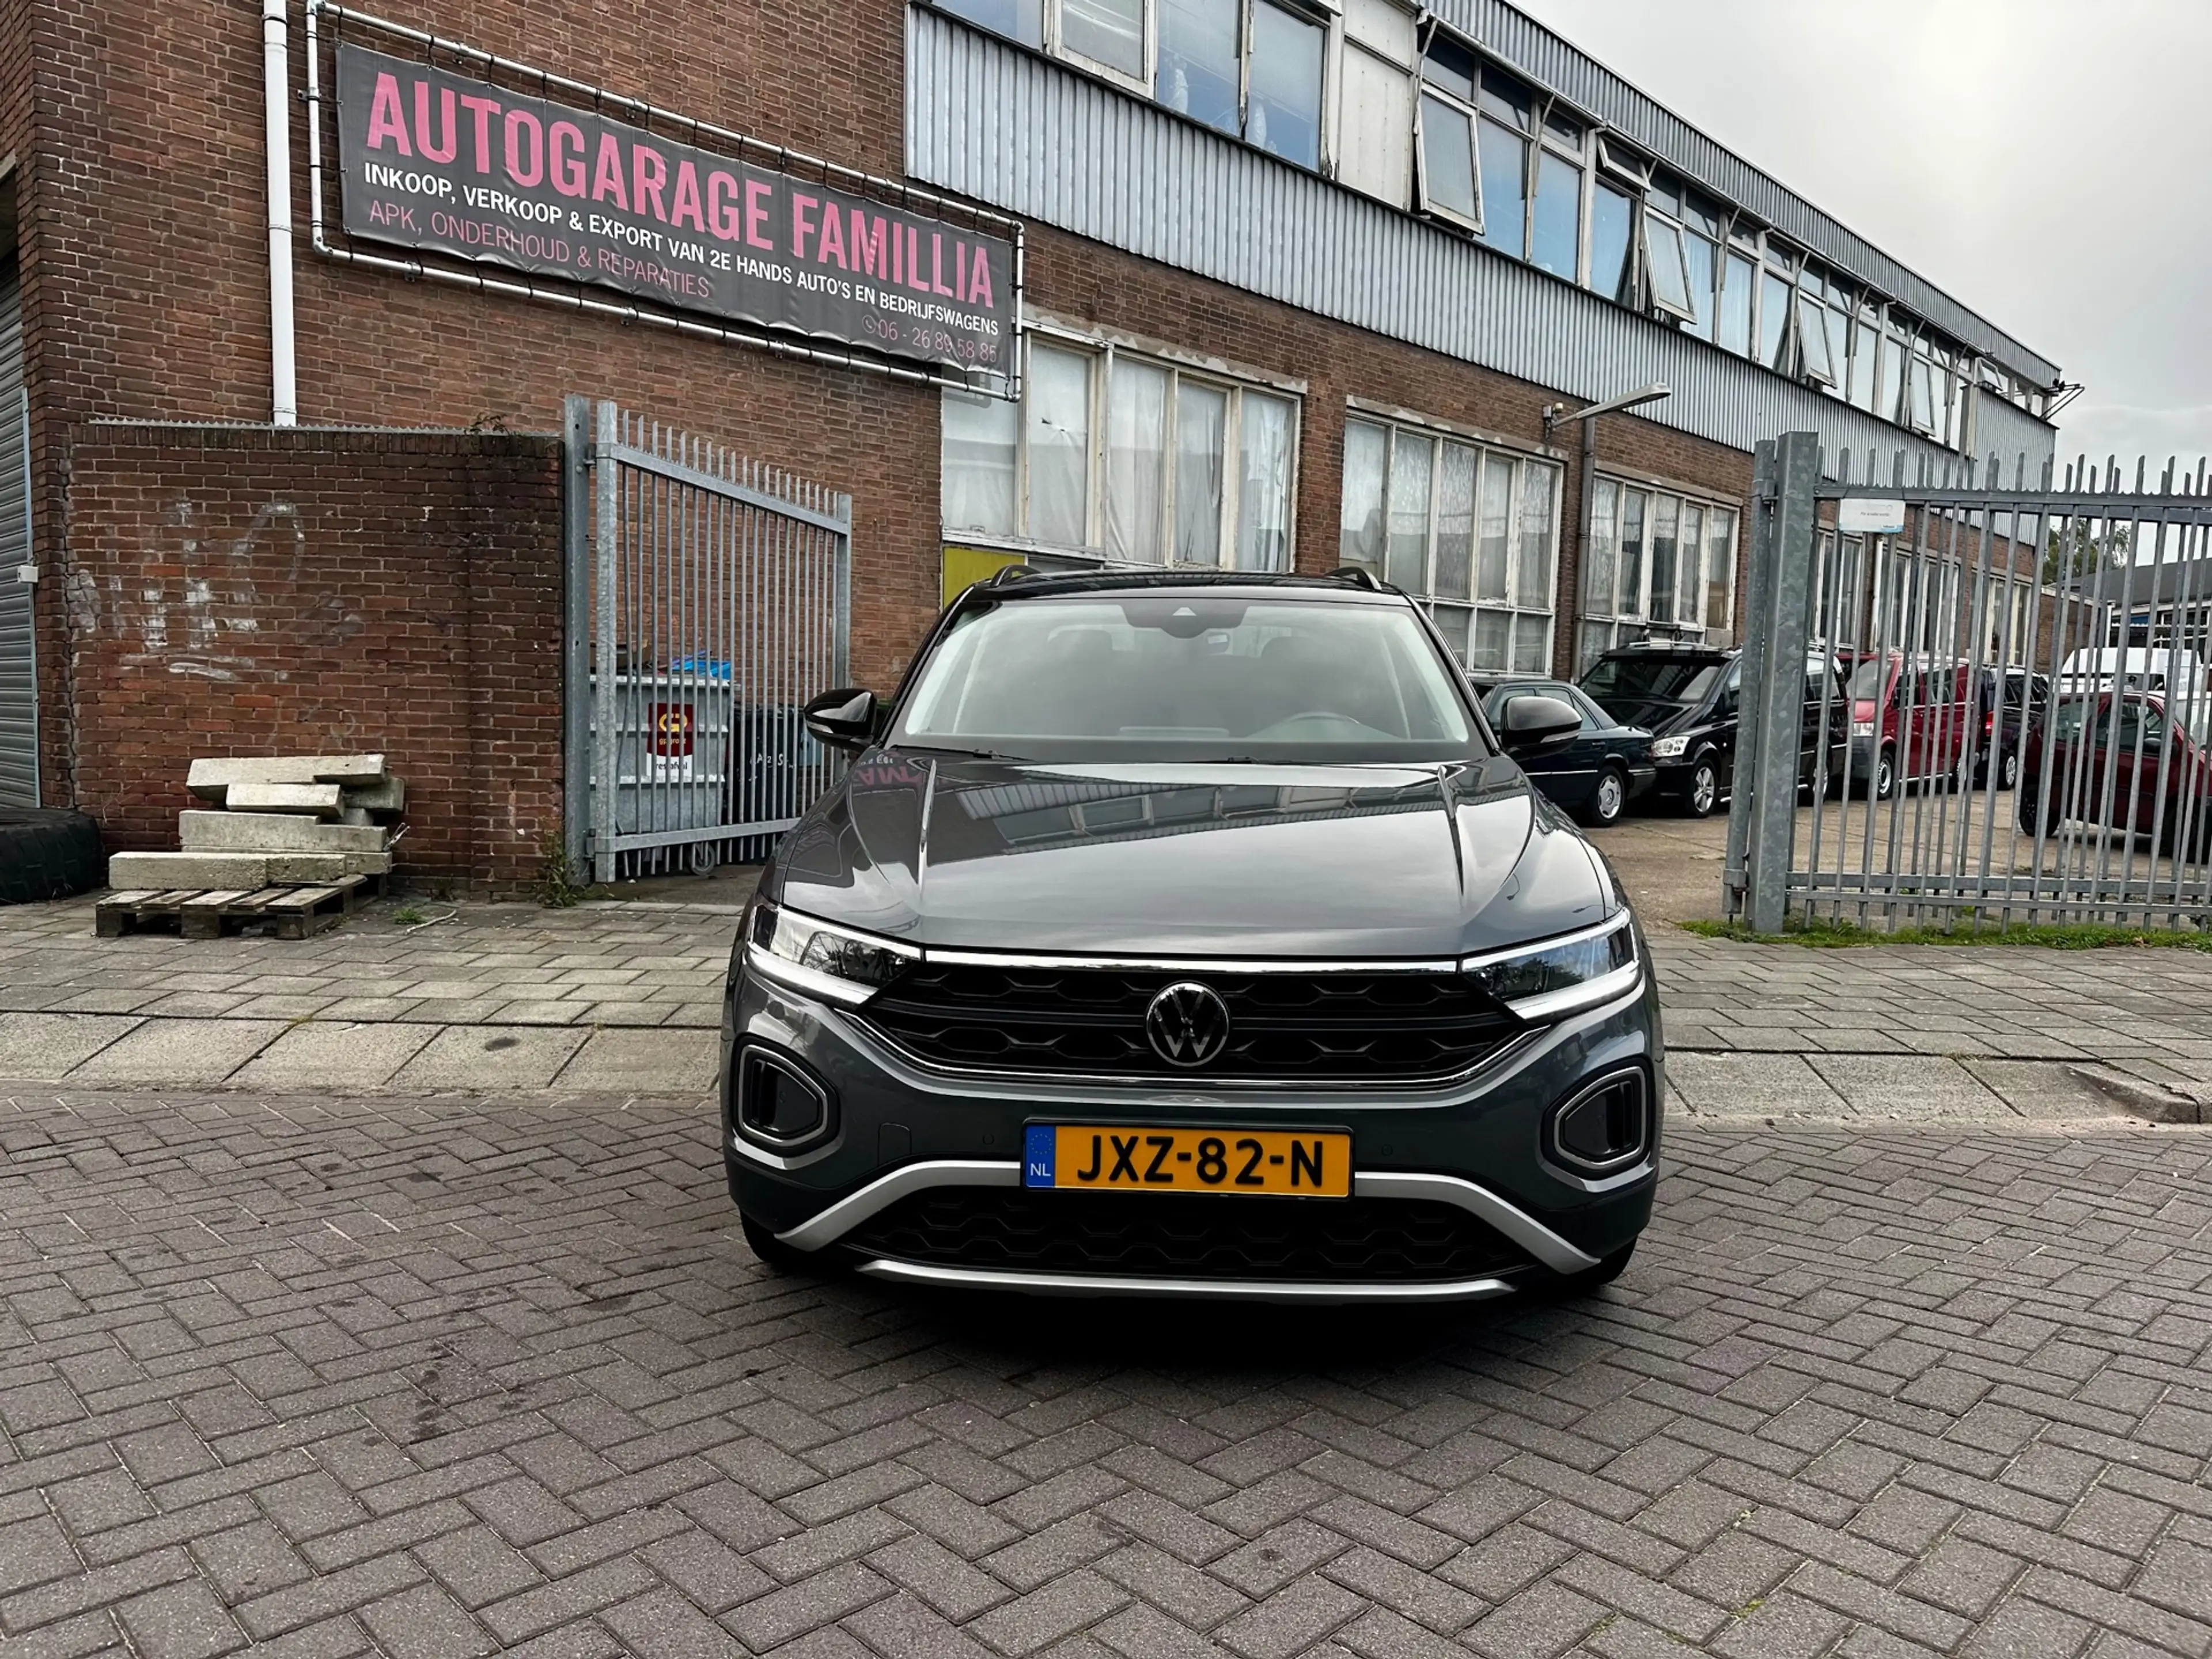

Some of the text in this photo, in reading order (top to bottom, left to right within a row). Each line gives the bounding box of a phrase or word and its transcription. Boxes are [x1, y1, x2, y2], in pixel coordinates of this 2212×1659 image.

[366, 71, 994, 308] AUTOGARAGE FAMILLIA
[365, 162, 999, 336] INKOOP, VERKOOP & EXPORT VAN 2E HANDS AUTO'S EN BEDRIJFSWAGENS
[369, 199, 709, 297] APK, ONDERHOUD & REPARATIES
[878, 319, 898, 340] 06
[912, 327, 930, 349] 26
[957, 338, 975, 358] 58
[979, 342, 997, 363] 85
[1030, 1135, 1323, 1187] NL JXZ-82-N
